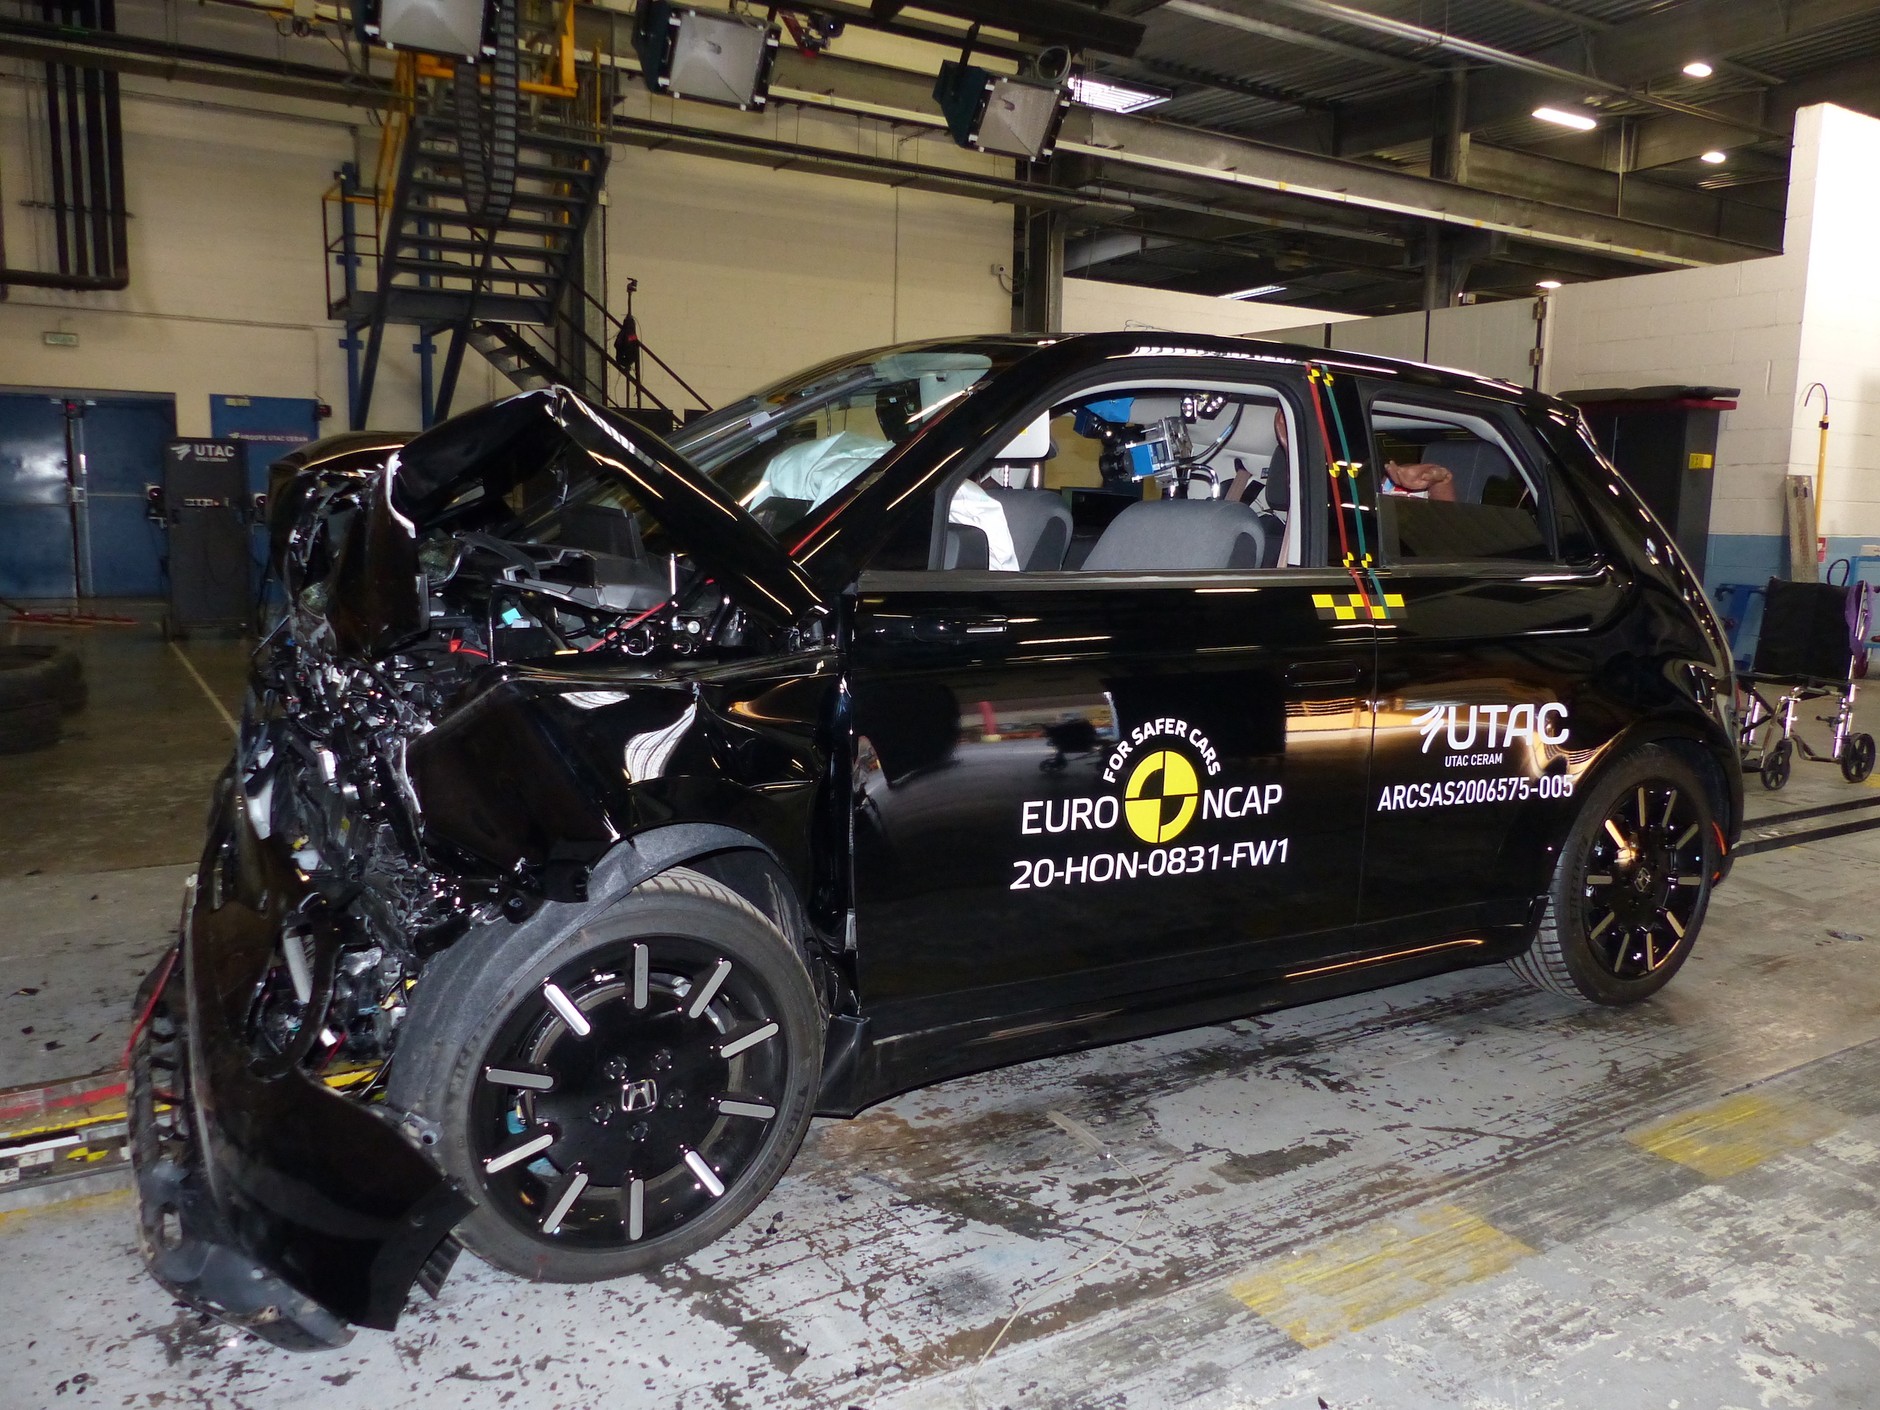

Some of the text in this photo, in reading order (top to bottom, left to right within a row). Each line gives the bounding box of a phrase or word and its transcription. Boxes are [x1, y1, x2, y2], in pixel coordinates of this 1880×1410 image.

[194, 444, 235, 457] UTAC
[1103, 718, 1221, 783] FOR SAFER CARS
[1447, 702, 1570, 751] UTAC
[1445, 753, 1503, 768] UTAC CERAM
[1021, 784, 1283, 835] EURO NCAP
[1377, 774, 1574, 811] ARCSAS2006575-005
[1009, 837, 1289, 890] 20-HON-0831-FW1
